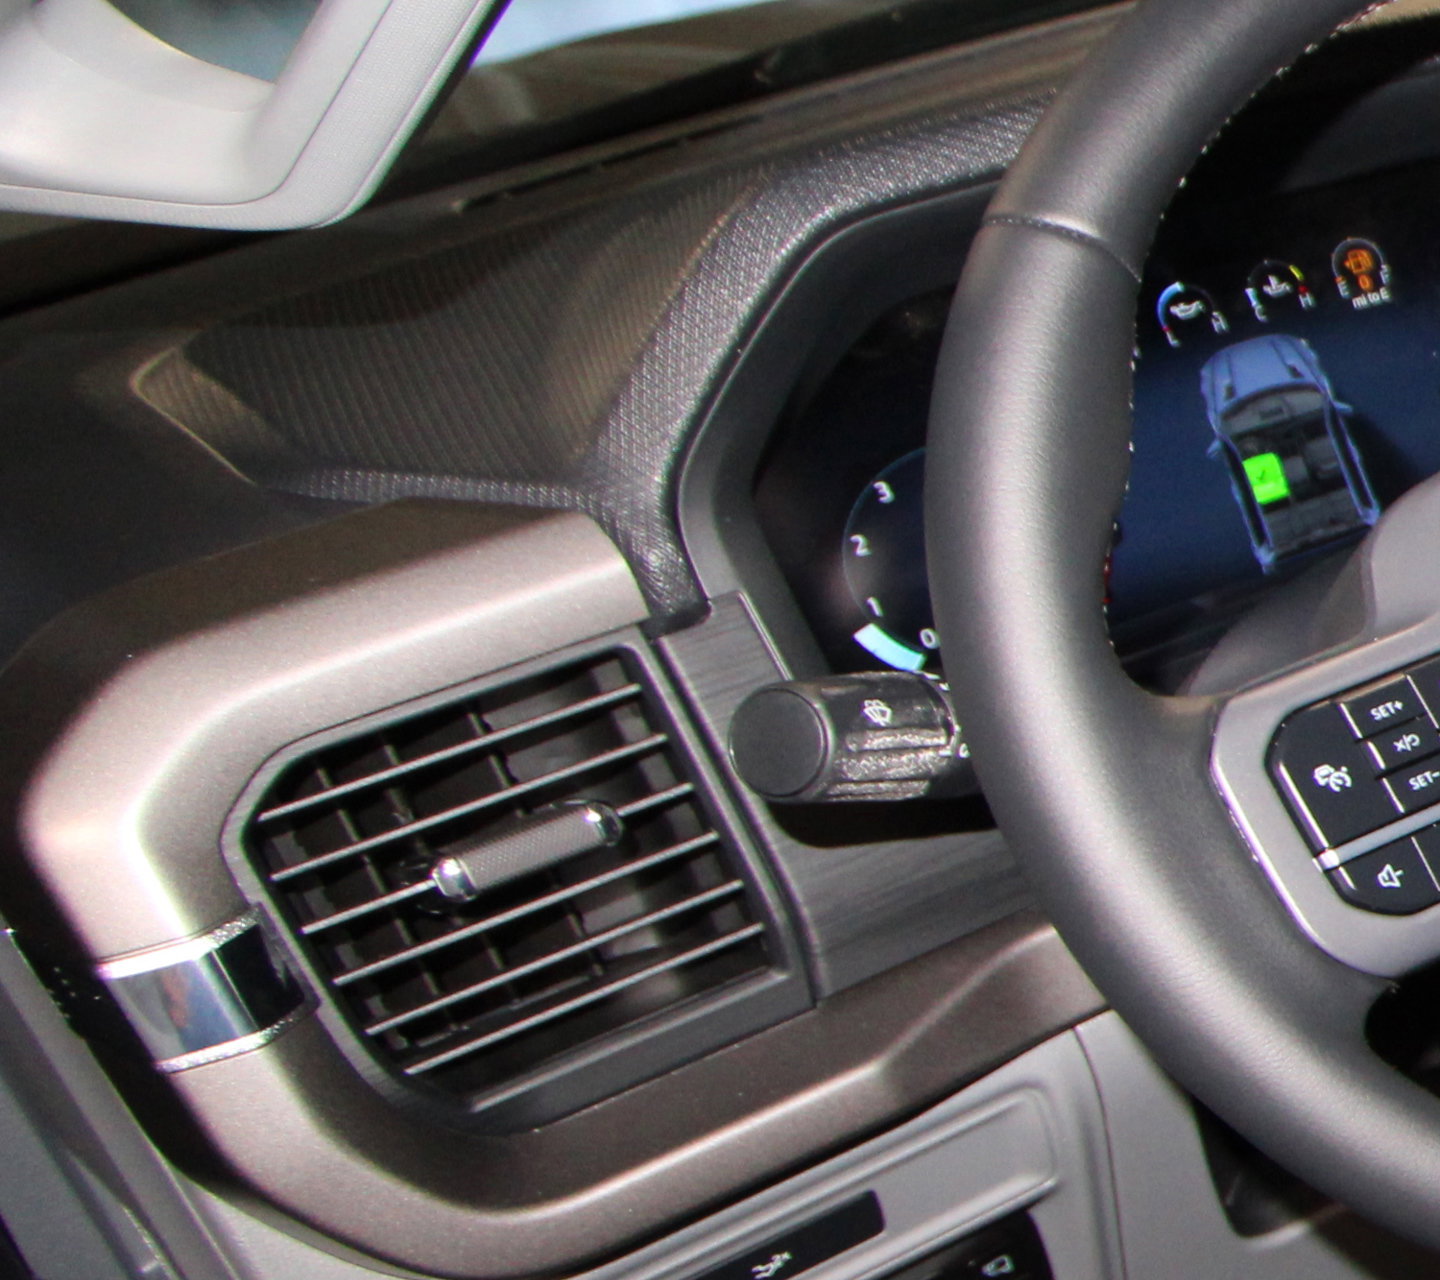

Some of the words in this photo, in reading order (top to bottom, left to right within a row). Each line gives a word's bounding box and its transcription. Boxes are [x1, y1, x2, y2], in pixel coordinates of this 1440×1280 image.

[1298, 292, 1314, 309] H
[1337, 281, 1351, 299] E
[872, 480, 896, 505] 3
[849, 533, 873, 557] 2
[866, 596, 884, 618] 1
[1370, 700, 1404, 721] SET+
